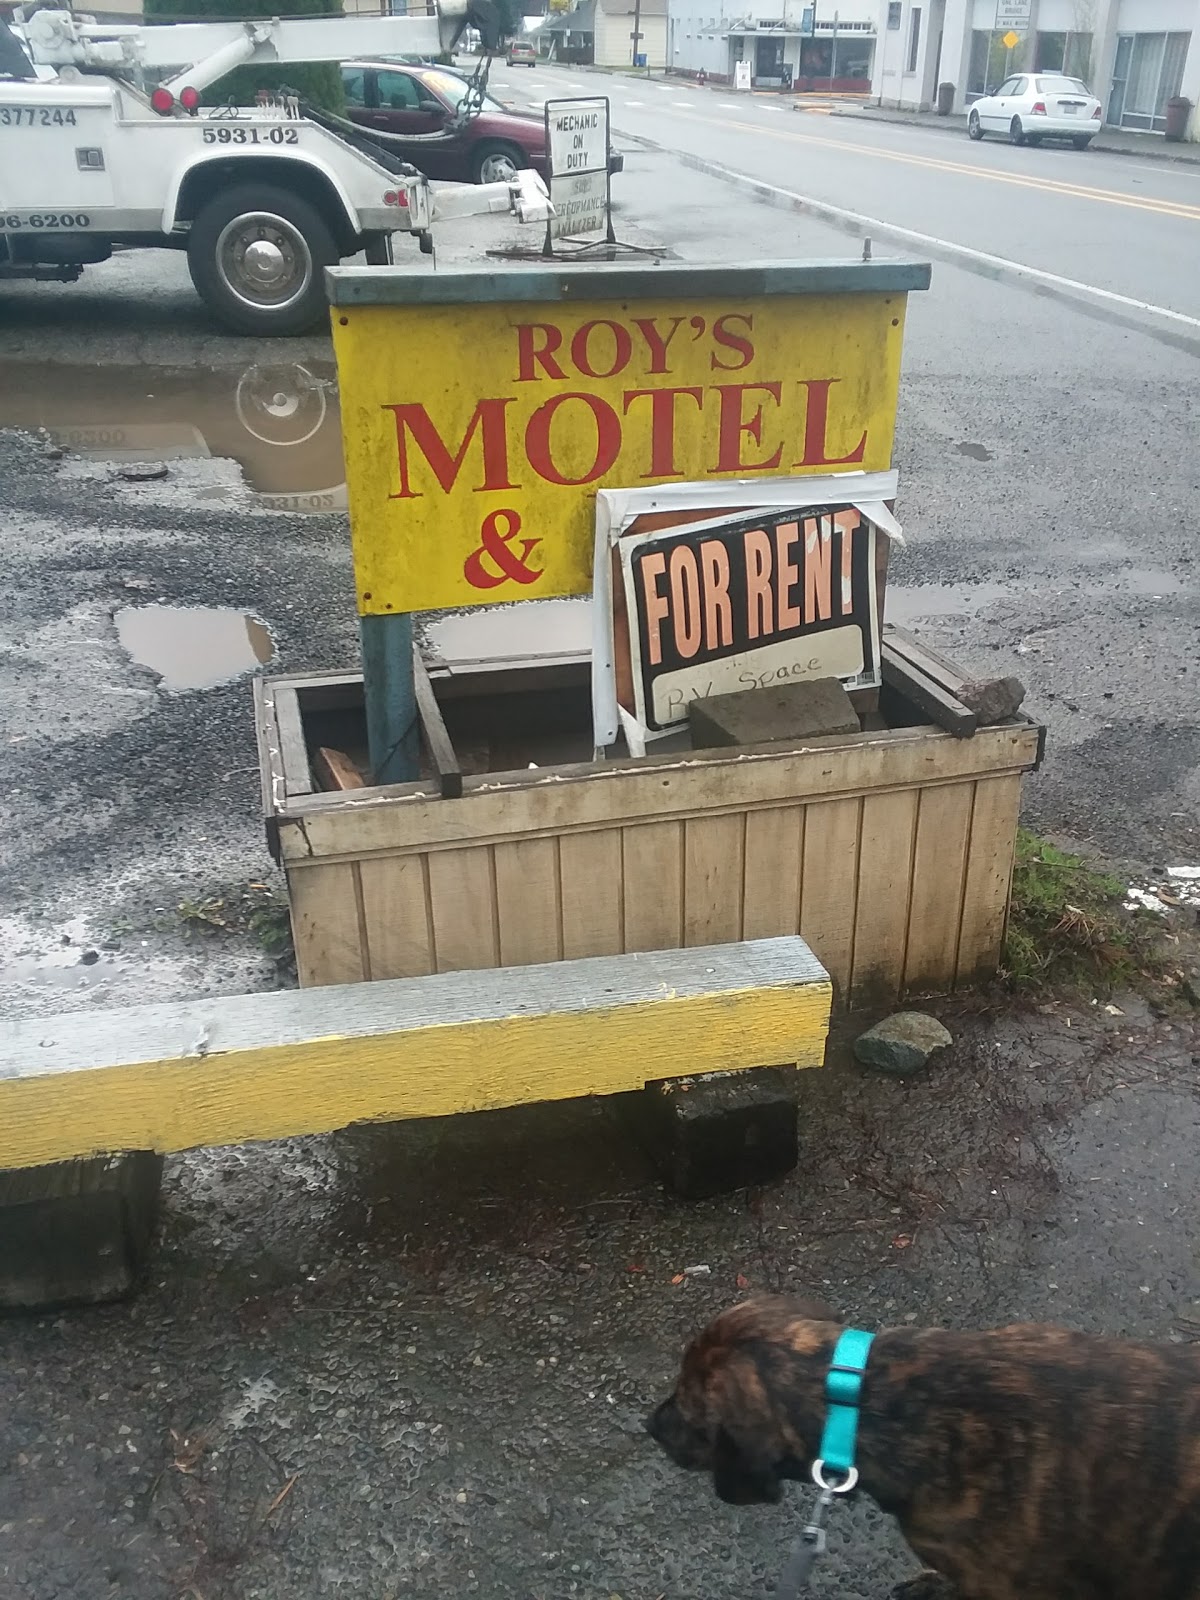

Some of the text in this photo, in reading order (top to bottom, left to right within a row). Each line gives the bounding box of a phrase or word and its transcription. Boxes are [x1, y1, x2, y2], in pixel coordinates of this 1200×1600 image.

[0, 108, 77, 126] 377244
[556, 113, 599, 131] MECHANIC
[203, 126, 299, 145] 5931-02
[573, 134, 584, 149] ON
[567, 152, 589, 169] DUTY
[511, 313, 755, 383] ROY'S
[381, 378, 868, 499] MOTEL
[463, 508, 543, 589] &
[641, 508, 861, 665] FOR RENT
[739, 656, 822, 690] Space
